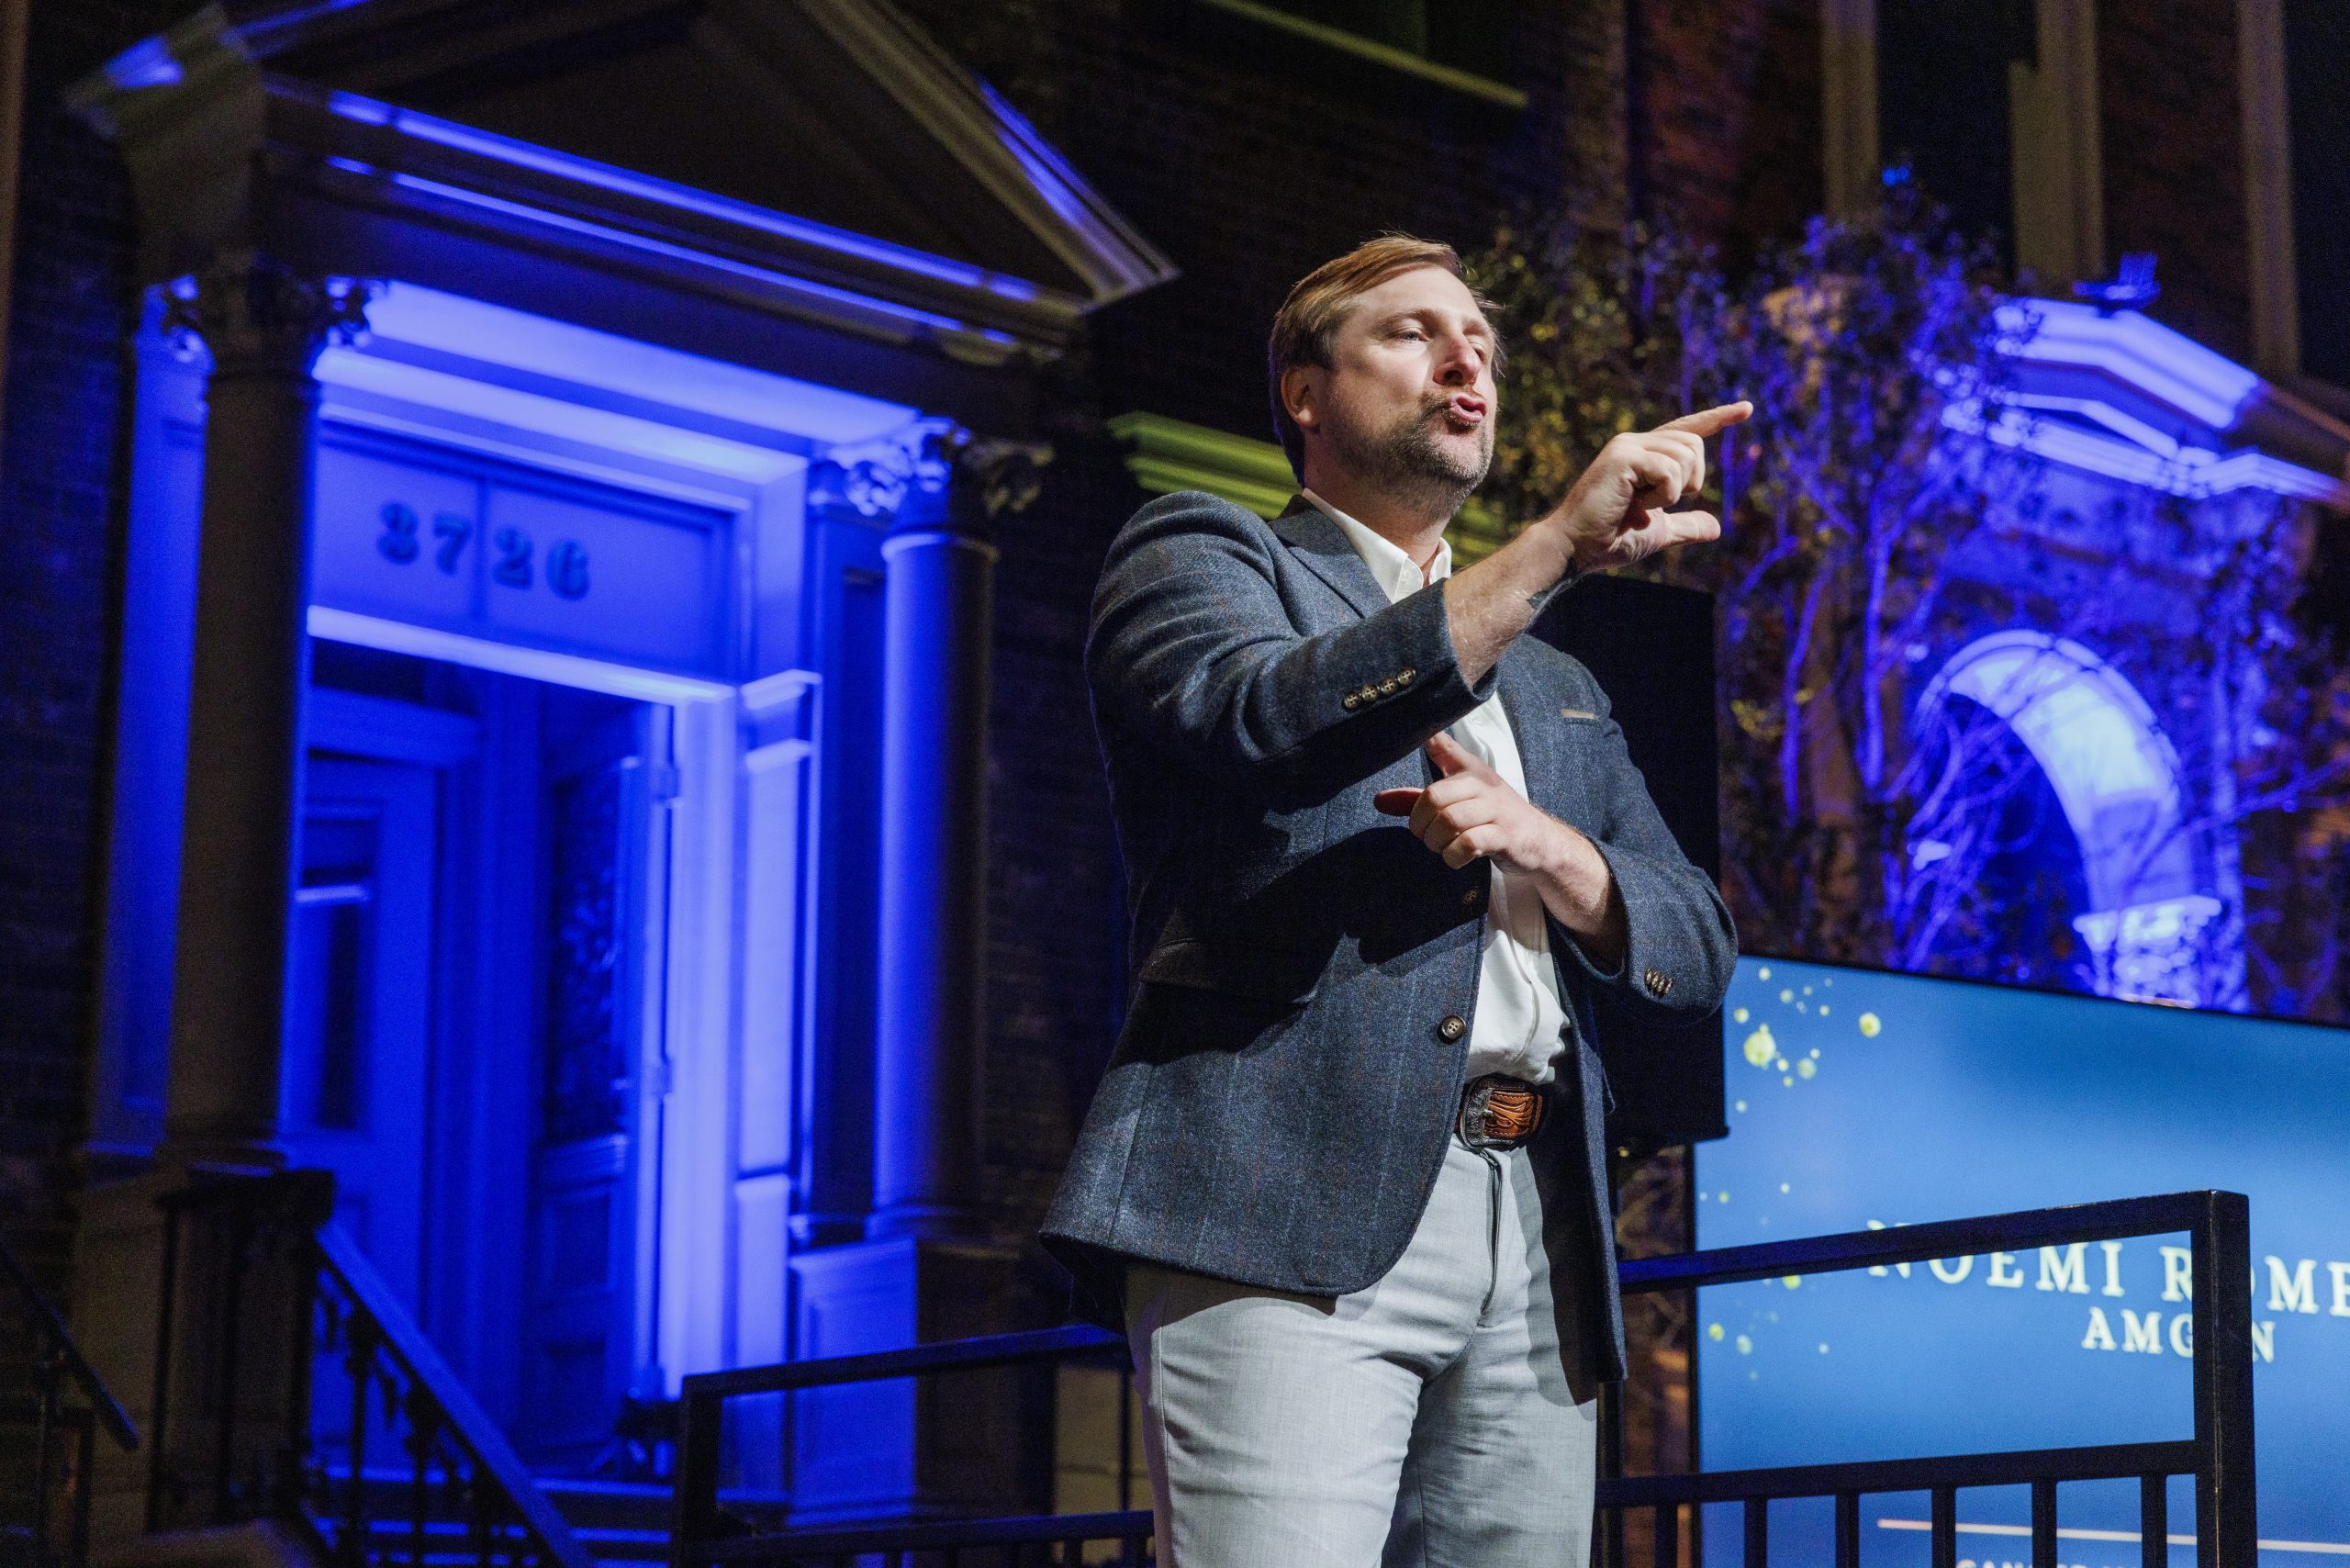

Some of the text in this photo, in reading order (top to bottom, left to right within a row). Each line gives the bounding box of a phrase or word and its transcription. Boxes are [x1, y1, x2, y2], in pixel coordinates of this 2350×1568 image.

[376, 502, 590, 601] 3726
[2159, 1246, 2350, 1316] RME
[2081, 1306, 2276, 1363] AMGN
